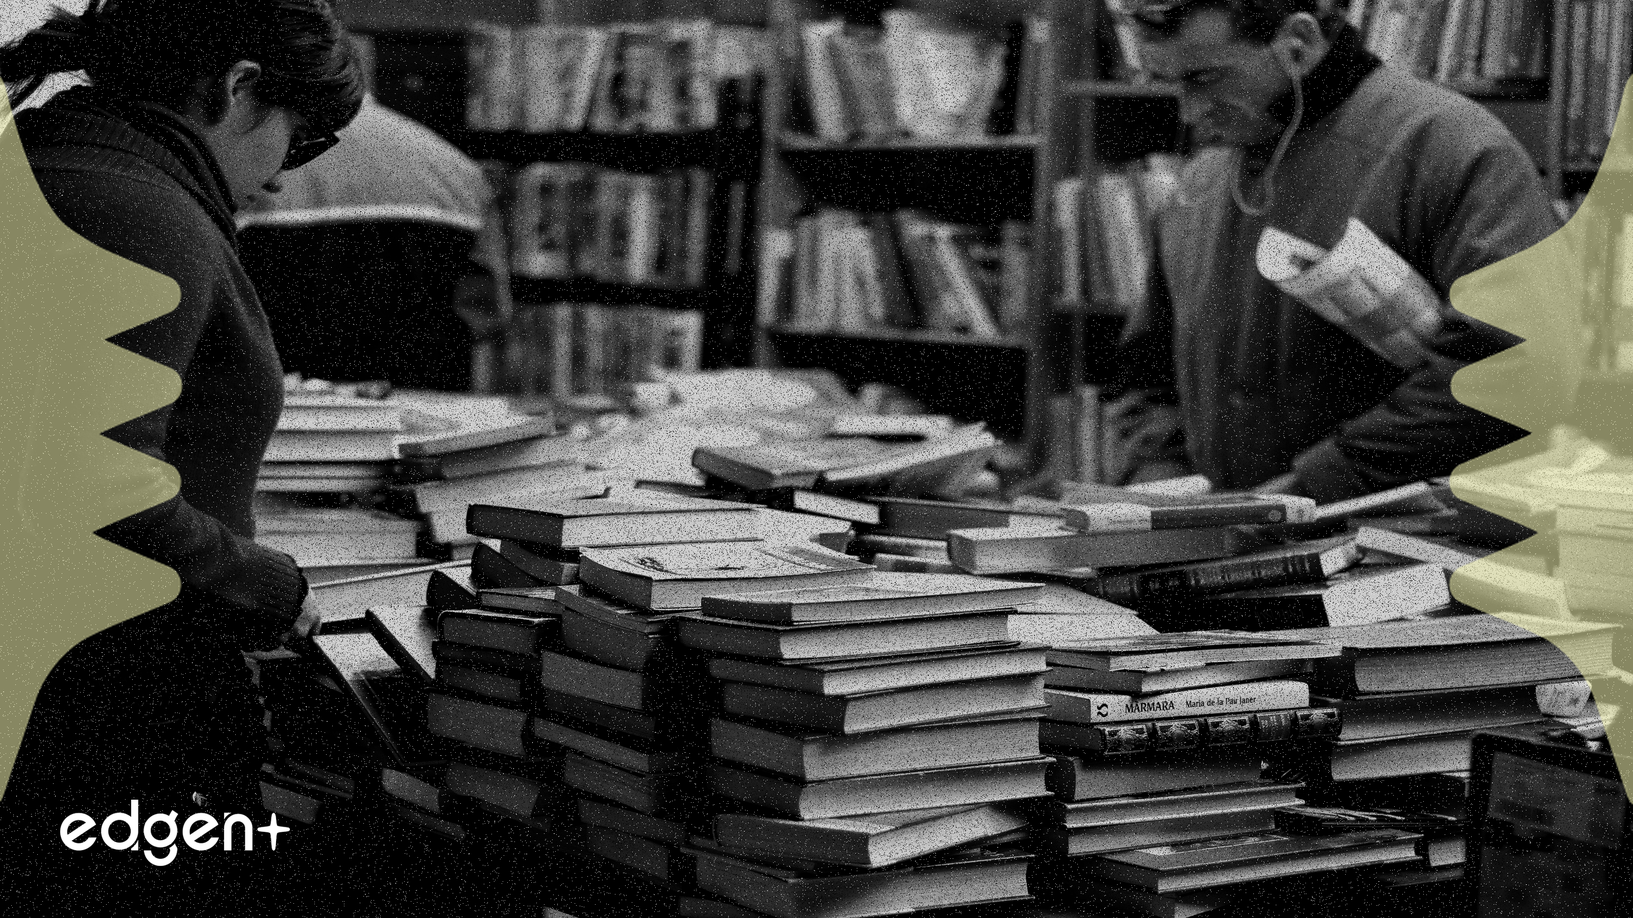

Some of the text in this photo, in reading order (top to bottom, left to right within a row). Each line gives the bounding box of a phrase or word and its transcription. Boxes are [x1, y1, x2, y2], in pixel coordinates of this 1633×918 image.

[1185, 700, 1205, 708] Maria
[1207, 698, 1215, 706] de
[1217, 697, 1224, 706] la
[1225, 697, 1238, 705] Pau
[1239, 696, 1257, 705] Janer
